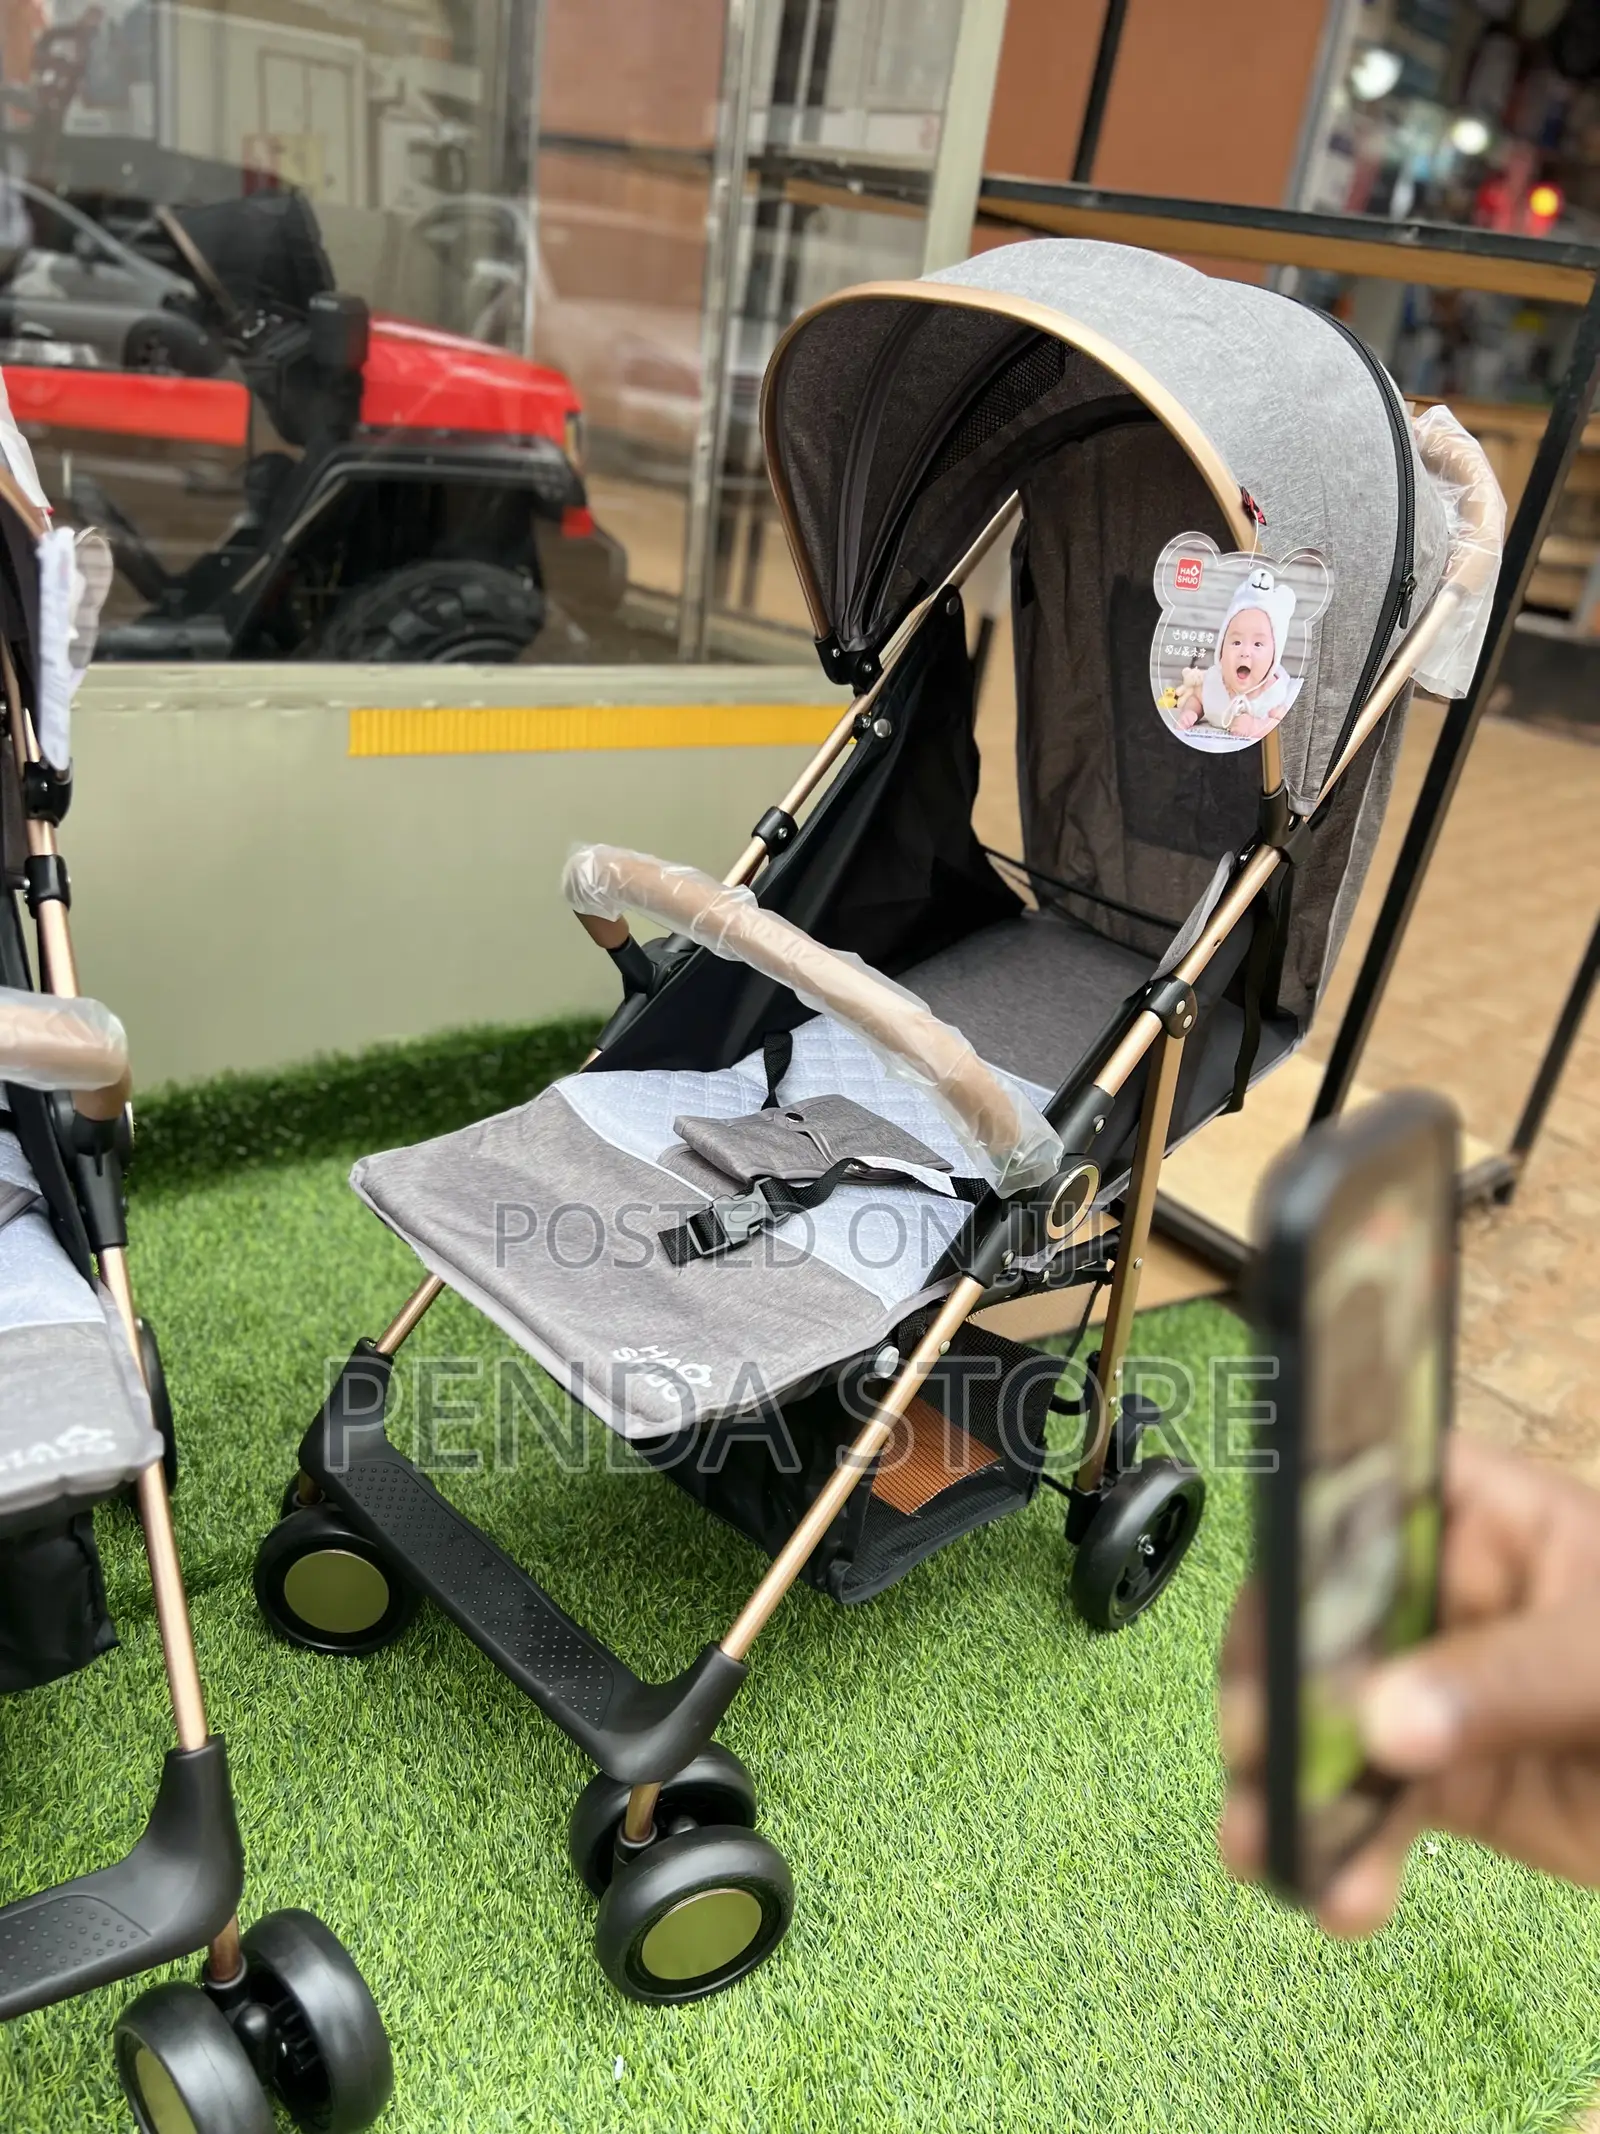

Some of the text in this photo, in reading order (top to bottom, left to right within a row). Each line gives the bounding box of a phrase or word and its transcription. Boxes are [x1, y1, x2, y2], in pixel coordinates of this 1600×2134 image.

[1180, 565, 1200, 577] HAO
[1177, 575, 1198, 585] SHUO
[639, 1344, 713, 1388] HAO
